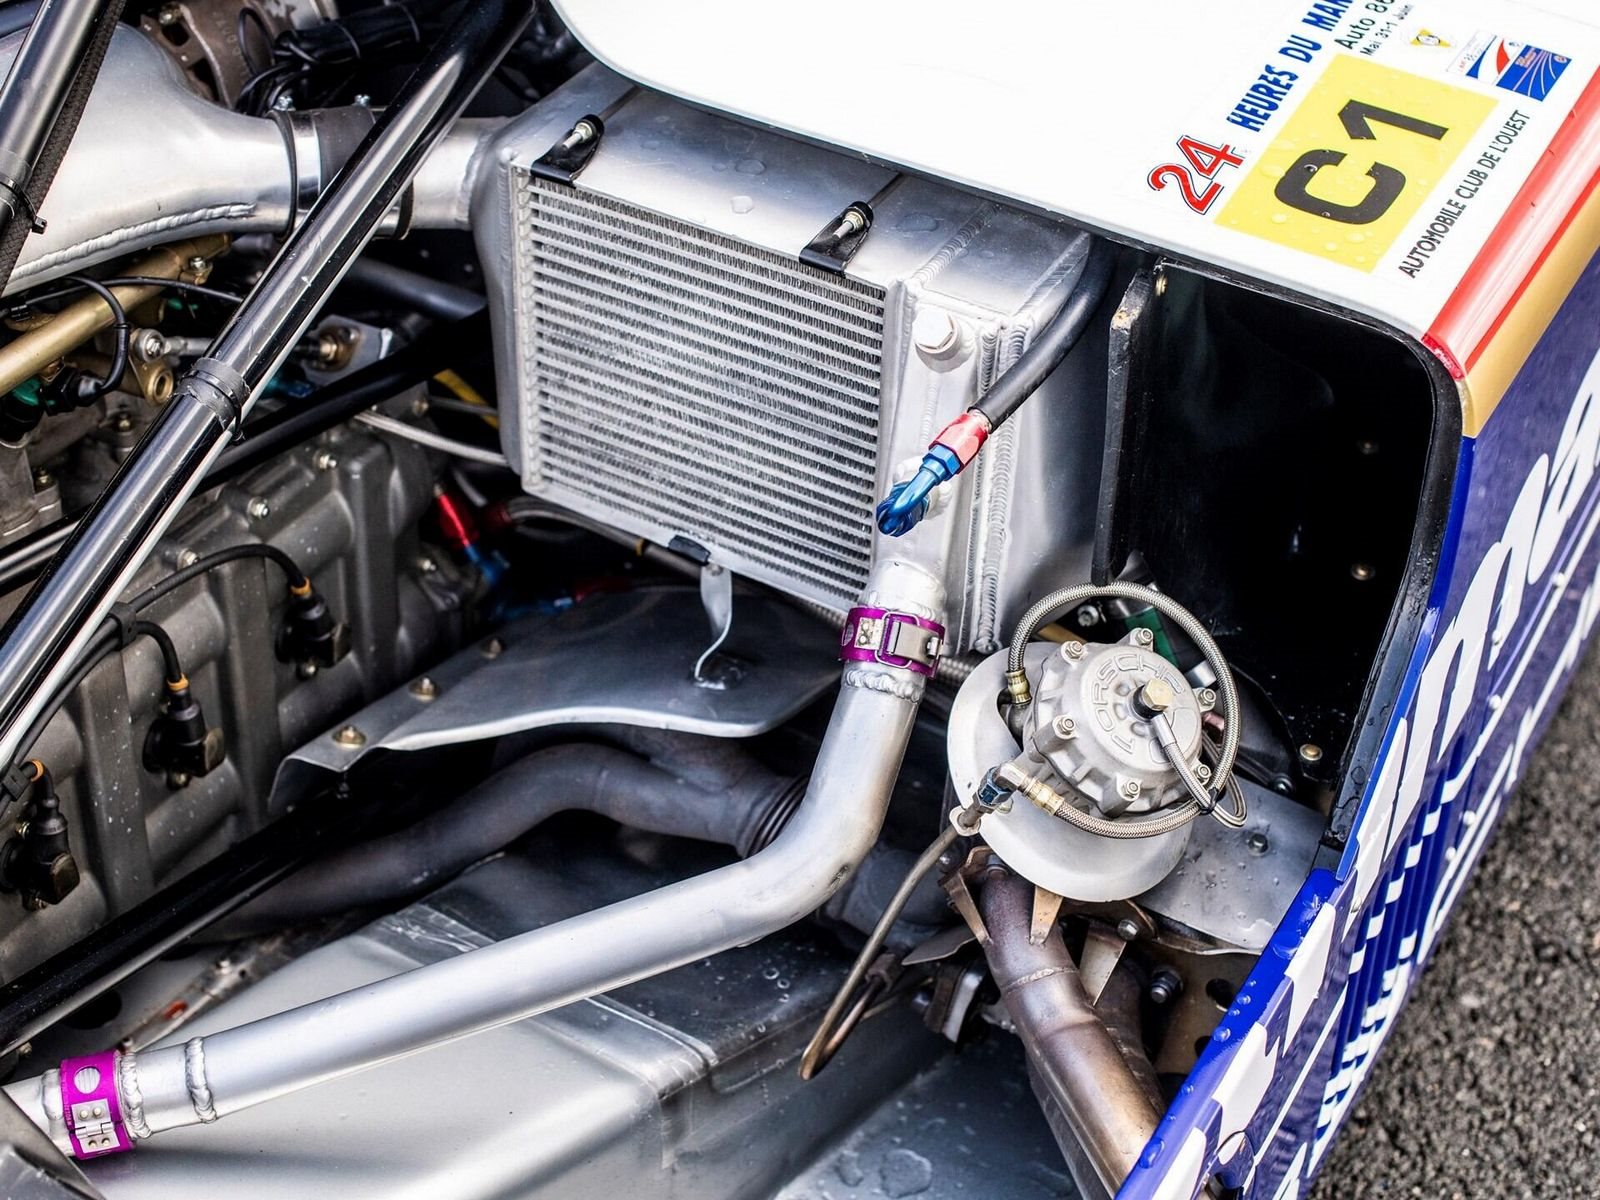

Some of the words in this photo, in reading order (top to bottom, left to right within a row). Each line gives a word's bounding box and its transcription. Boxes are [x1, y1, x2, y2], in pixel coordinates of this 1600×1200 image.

[1333, 18, 1375, 49] Auto
[1360, 40, 1382, 56] Mai
[1147, 135, 1245, 215] 24
[1226, 64, 1299, 132] HEURES
[1278, 34, 1322, 63] DU
[1488, 109, 1530, 153] L'OUEST
[1274, 99, 1449, 225] C1
[1477, 151, 1501, 170] DE
[1454, 169, 1488, 199] CLUB
[1398, 199, 1467, 279] AUTOMOBILE
